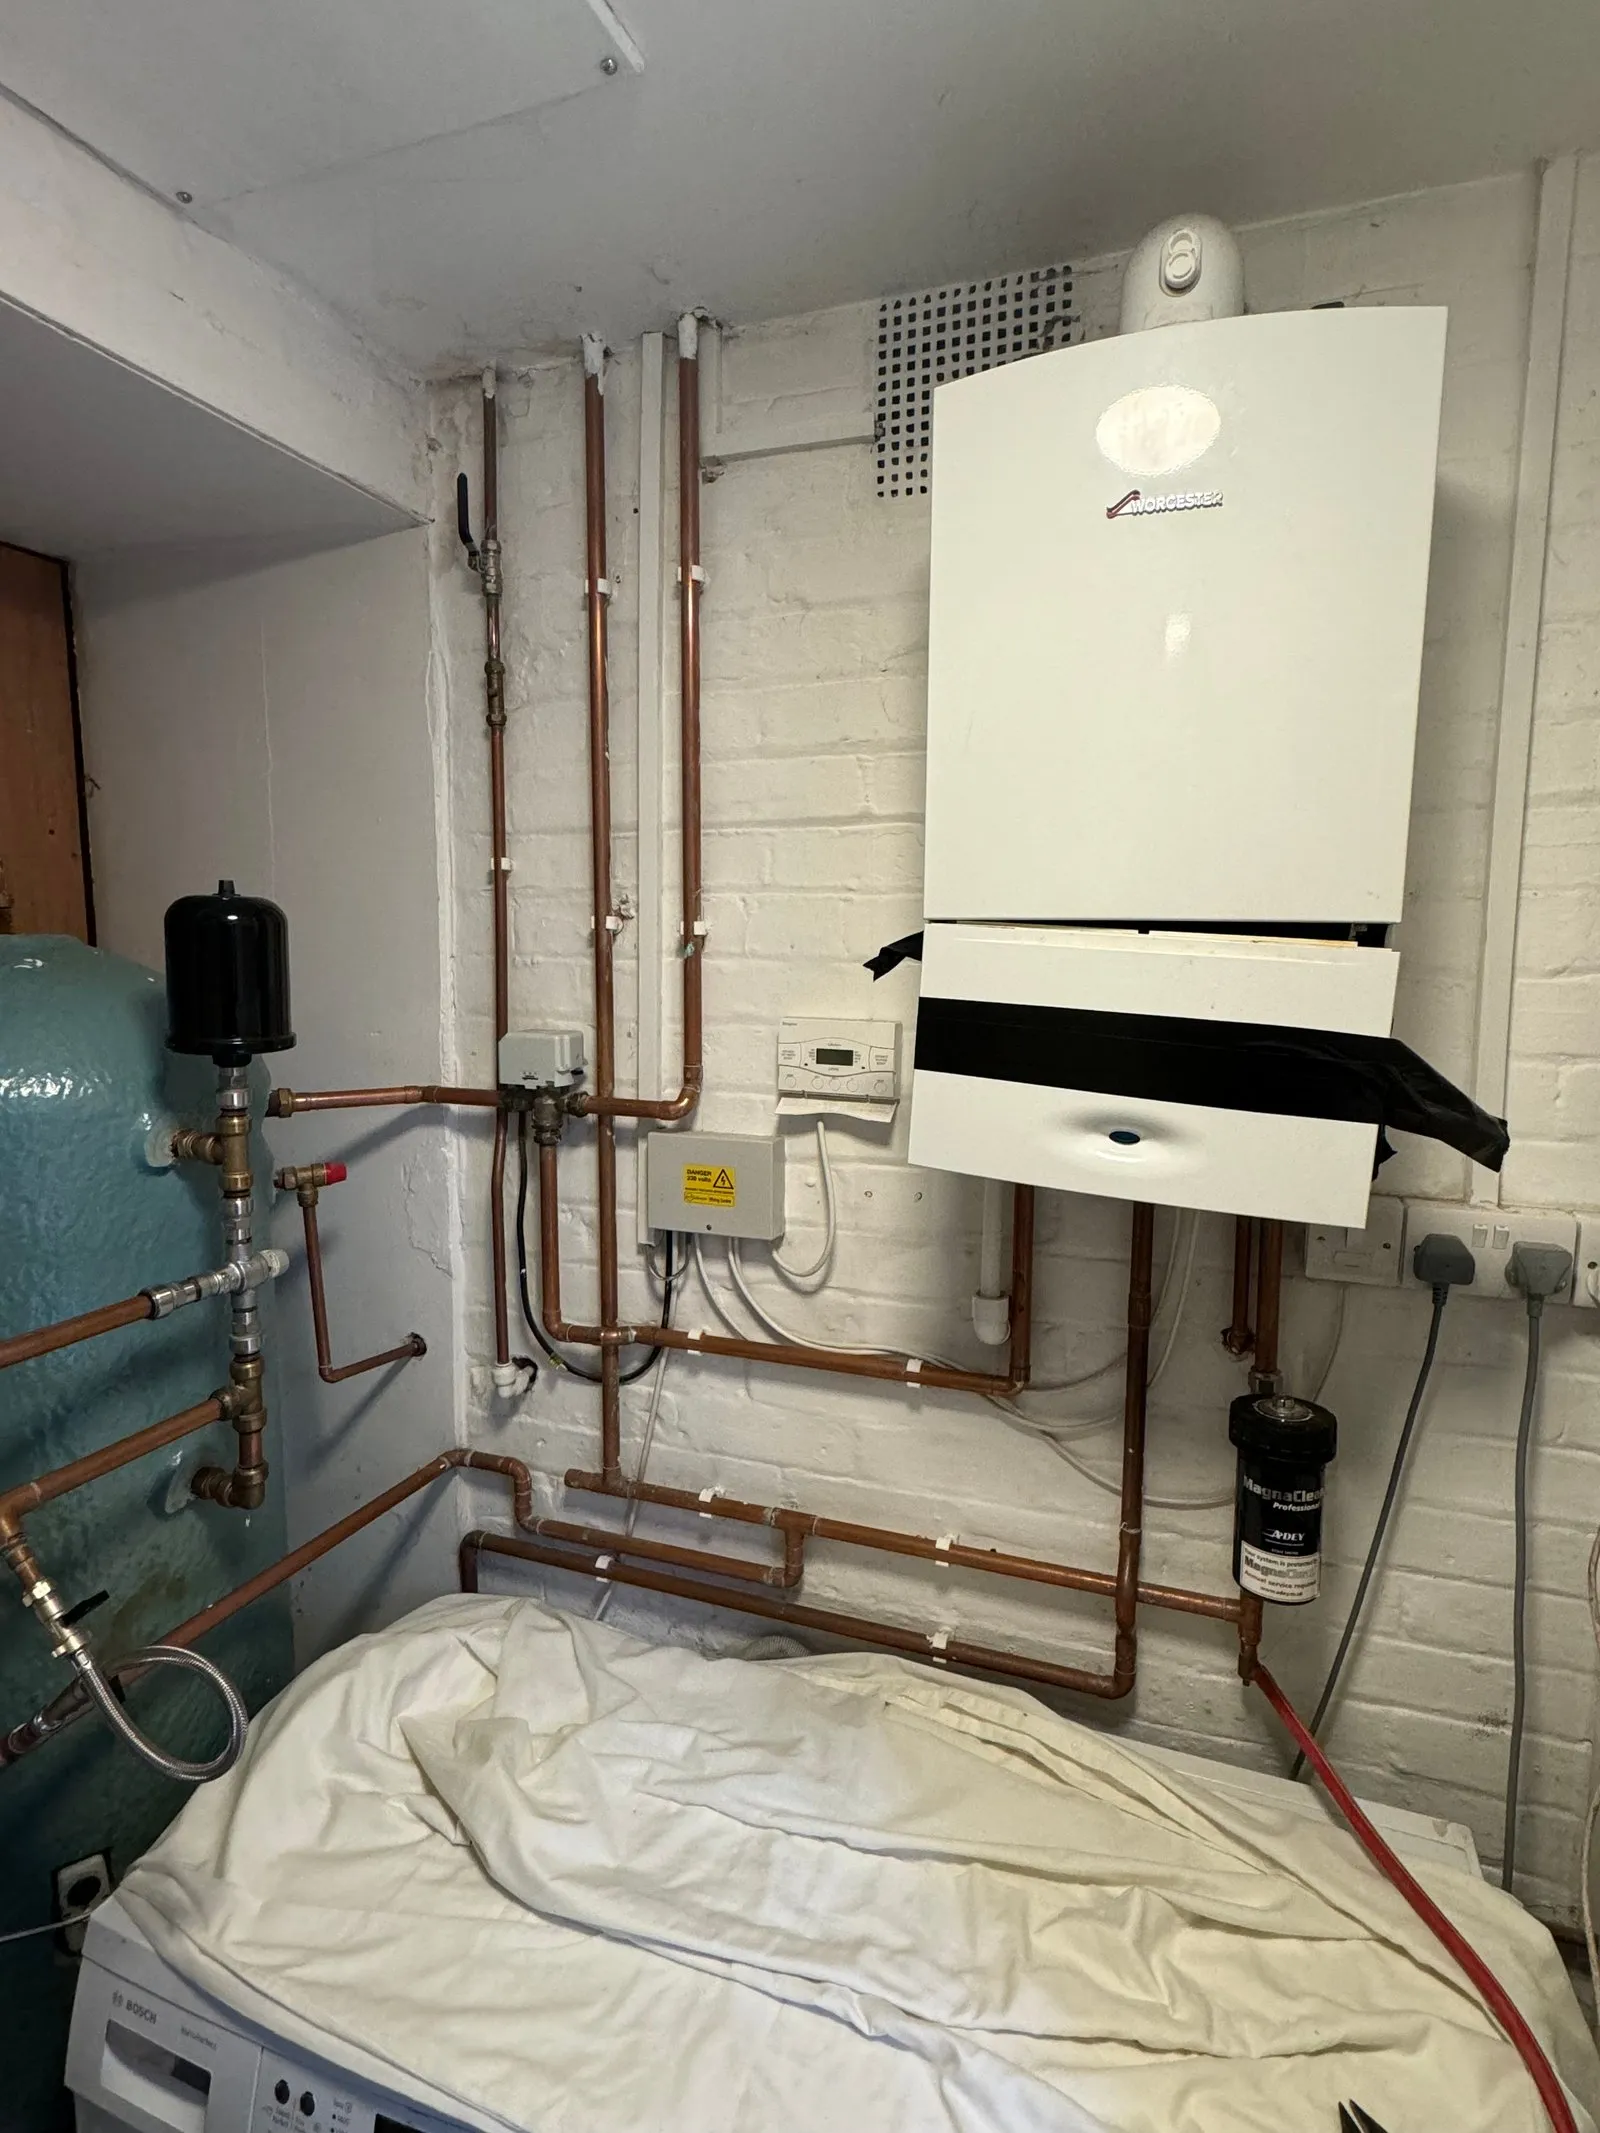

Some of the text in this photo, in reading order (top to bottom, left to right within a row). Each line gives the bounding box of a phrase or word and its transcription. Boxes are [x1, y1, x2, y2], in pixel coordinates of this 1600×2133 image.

[1131, 491, 1223, 516] WORCESTER
[1272, 1501, 1320, 1512] Professional
[1268, 1580, 1293, 1589] service
[126, 1999, 158, 2025] BOSCH
